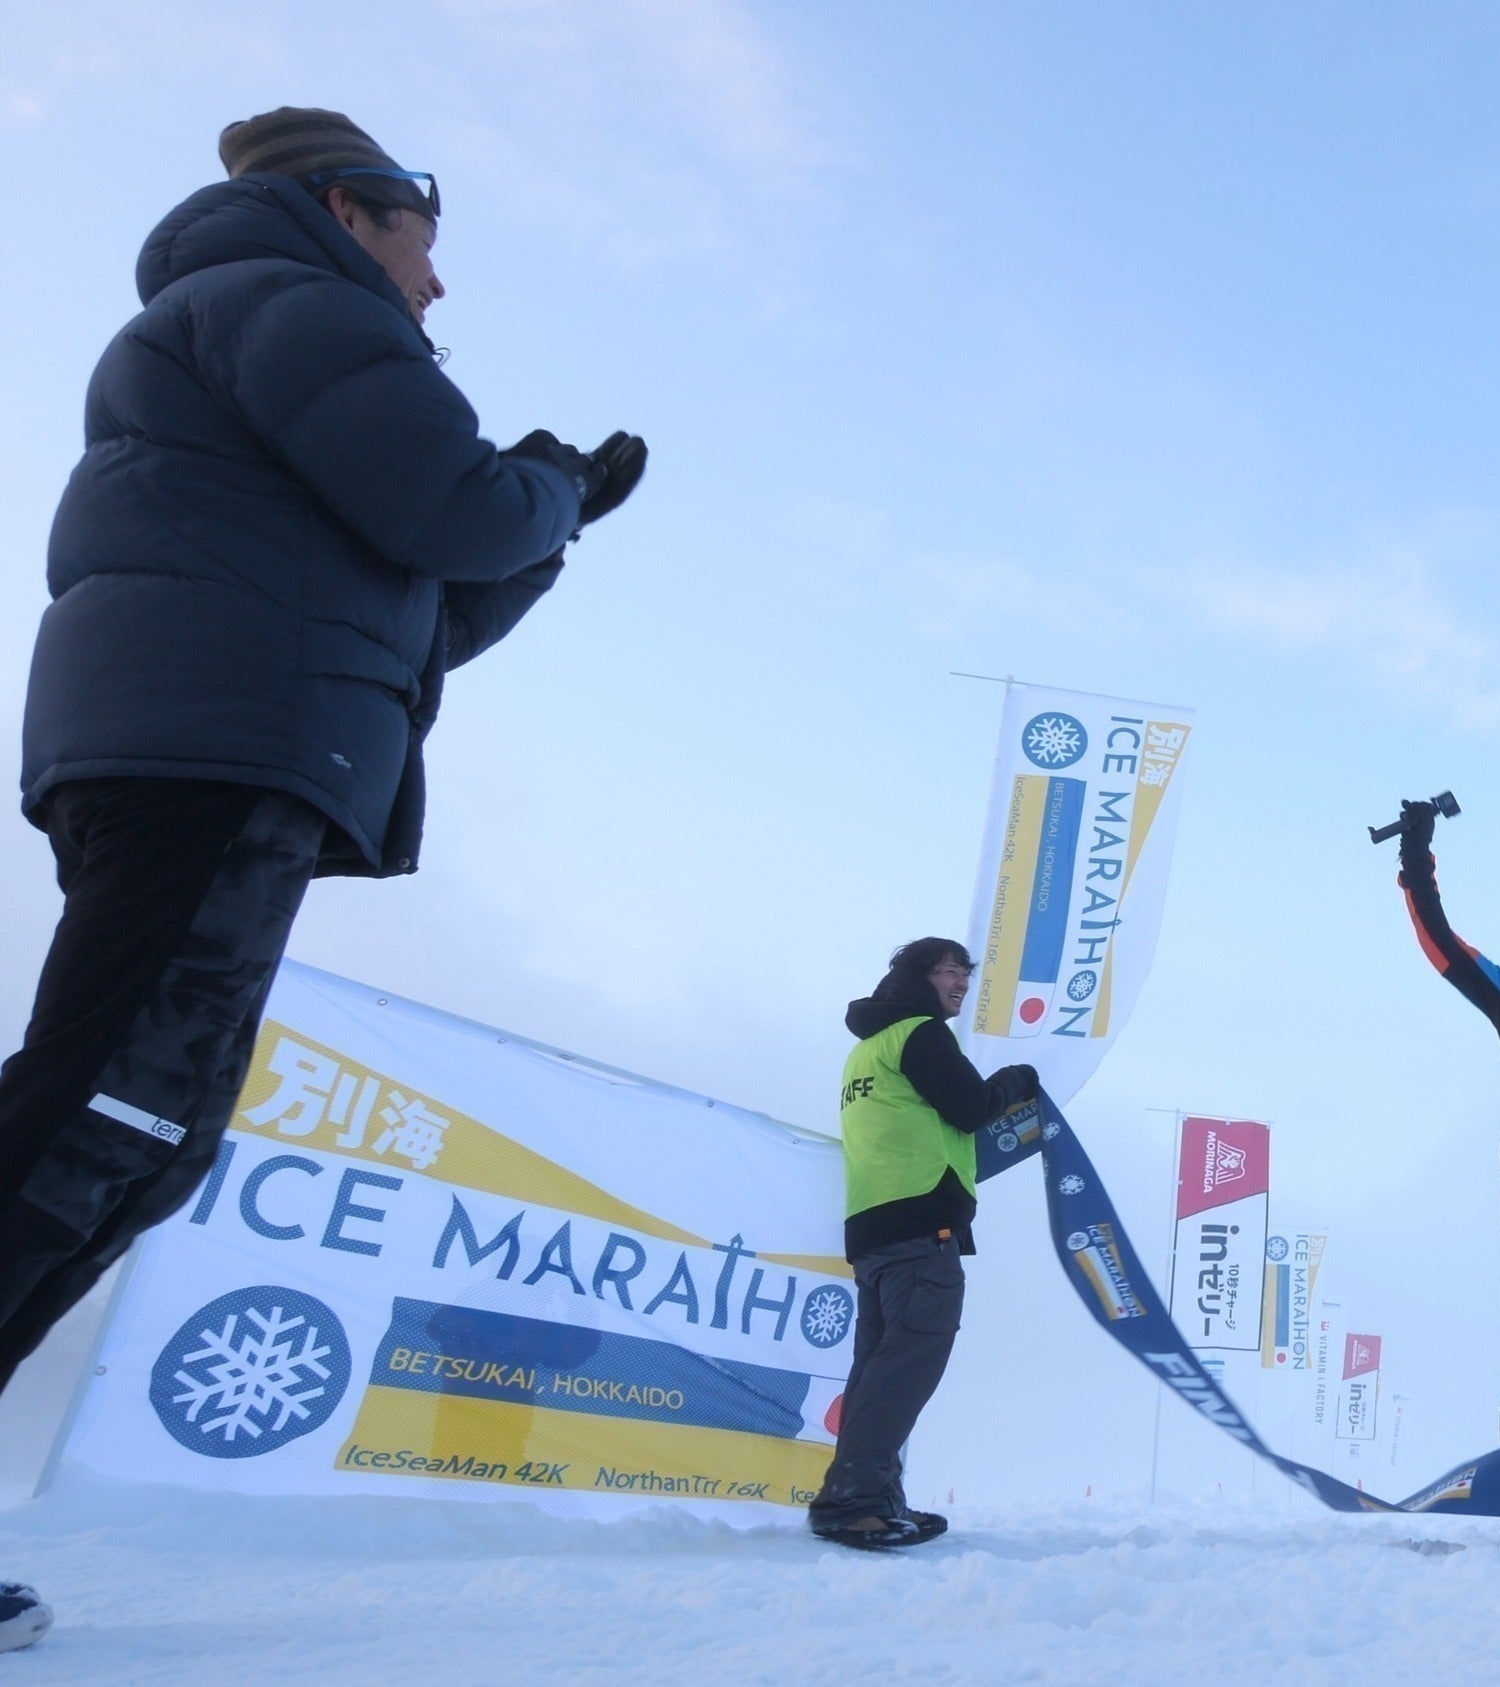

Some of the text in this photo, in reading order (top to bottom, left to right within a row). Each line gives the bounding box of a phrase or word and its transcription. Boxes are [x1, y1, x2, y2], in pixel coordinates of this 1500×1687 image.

[1140, 724, 1187, 787] 別海
[976, 776, 1026, 1032] IceSeaMan 42K NorthanTri 16K IceTri 2K
[1038, 846, 1056, 911] HOKKAIDO
[1051, 716, 1144, 1038] ICE MARATHON
[240, 1035, 451, 1170] 別海
[987, 1118, 1010, 1136] ICE
[1203, 1130, 1216, 1193] MORINAGA
[189, 1138, 855, 1349] ICE MARATHO
[1197, 1223, 1239, 1337] inゼリー
[1225, 1264, 1239, 1330] 10秒チャージ
[1292, 1234, 1308, 1369] ICE MARATHON
[552, 1373, 684, 1411] HOKKAIDO
[1315, 1384, 1325, 1424] FACTORY
[345, 1444, 507, 1481] IceSeaMan
[514, 1461, 570, 1484] 42K
[594, 1467, 721, 1495] NorthanTri
[726, 1480, 769, 1499] 16K
